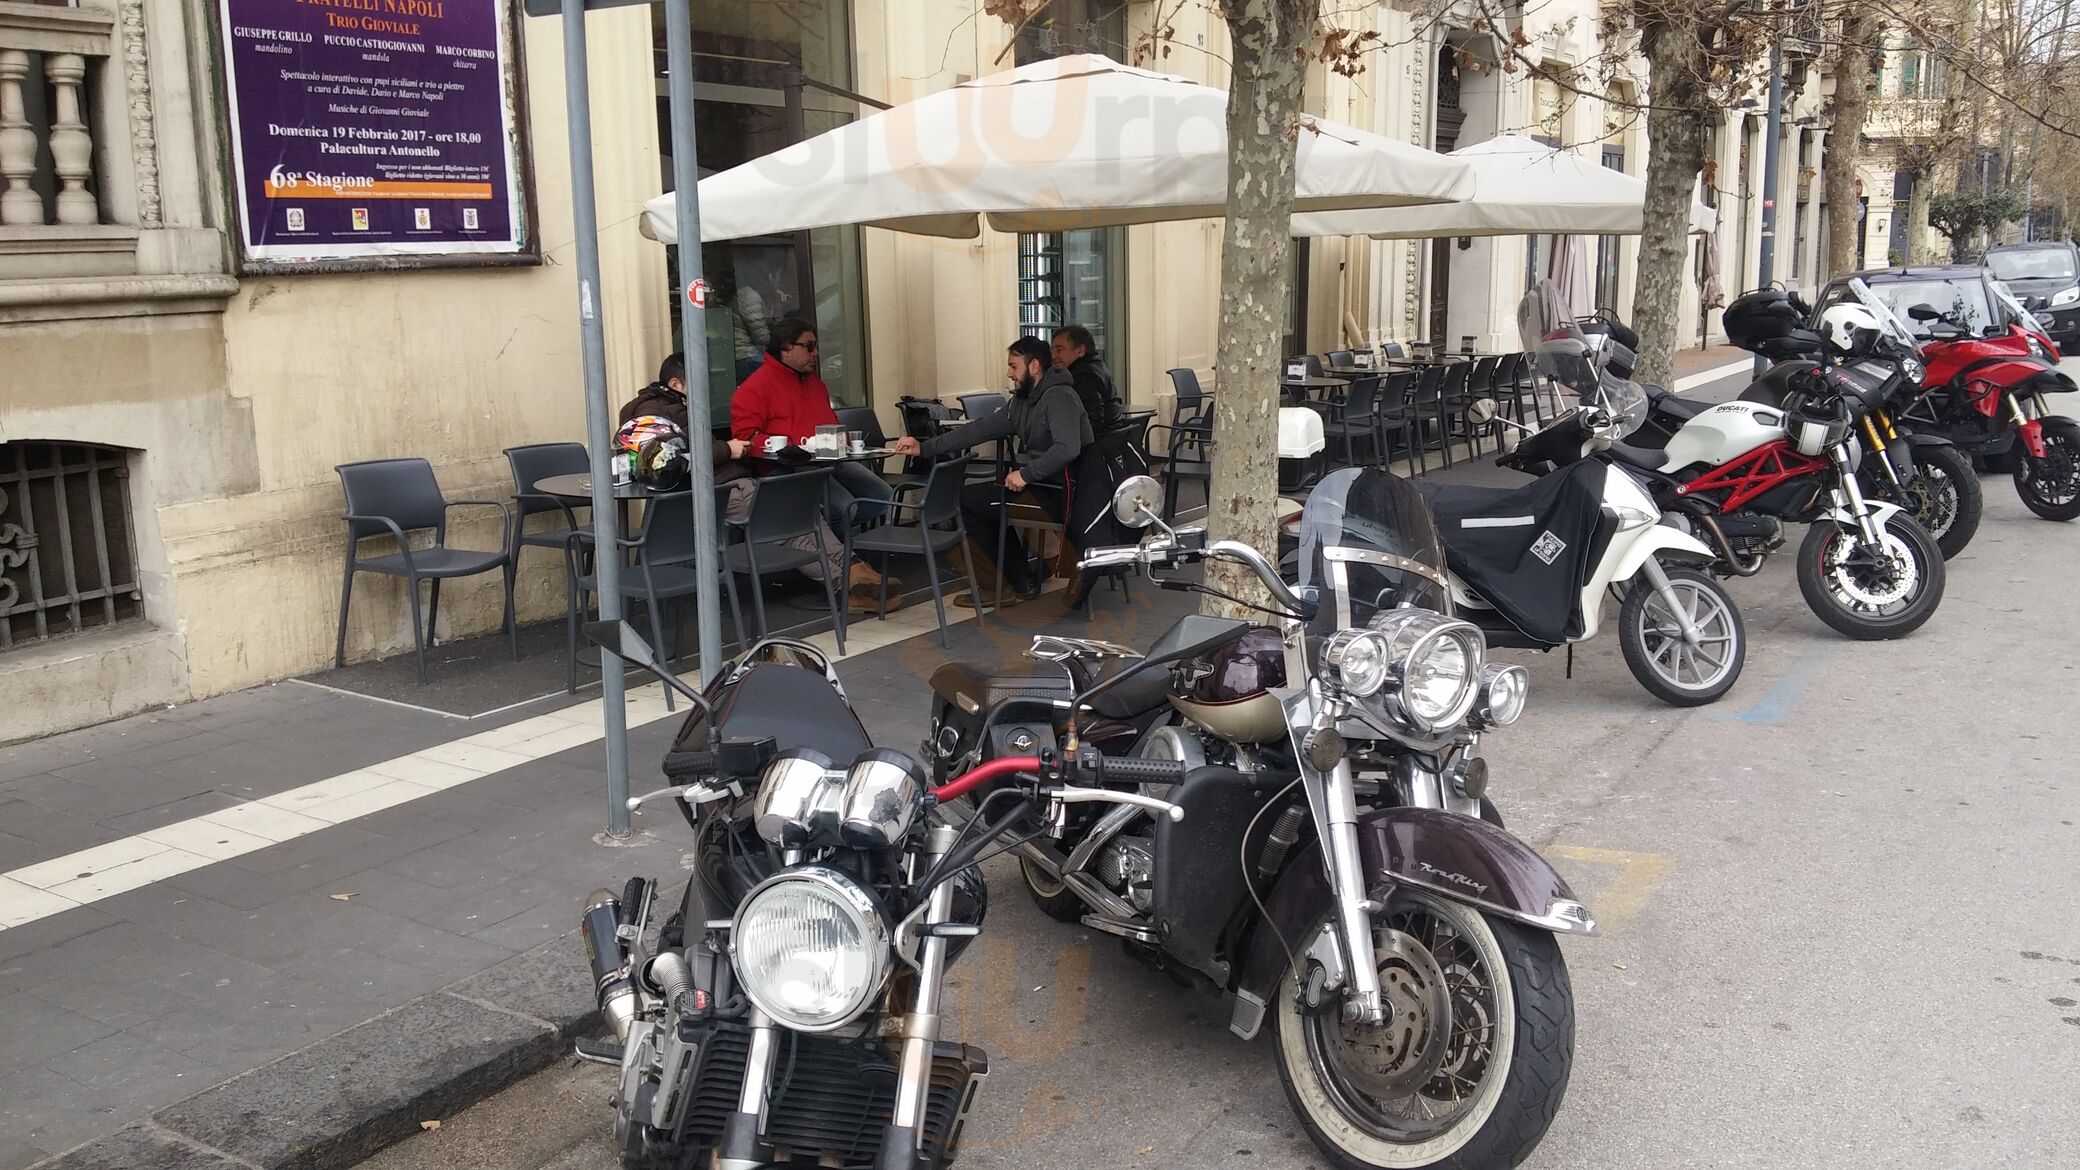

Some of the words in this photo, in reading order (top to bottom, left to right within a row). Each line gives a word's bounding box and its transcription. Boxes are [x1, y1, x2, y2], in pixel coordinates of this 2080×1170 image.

[385, 0, 443, 18] NAPOLI
[326, 12, 358, 29] TRIO
[361, 16, 420, 35] GIOVIALE
[234, 26, 277, 40] GIUSEPPE
[278, 30, 312, 43] GRILLO
[255, 43, 293, 55] mandolino
[323, 34, 356, 47] PUCCIO
[356, 37, 425, 53] CASTROGIOVANNI
[435, 44, 461, 56] MARCO
[462, 47, 495, 60] CORBINO
[452, 59, 477, 70] chitarra
[280, 69, 320, 81] Spettacolo
[321, 73, 359, 84] interattivo
[360, 77, 373, 85] con
[374, 77, 390, 88] pupi
[391, 78, 418, 88] siciliani
[425, 81, 437, 90] trio
[443, 82, 465, 92] plettro
[314, 86, 331, 95] cura
[333, 86, 340, 95] di
[371, 88, 392, 98] Dario
[399, 90, 421, 99] Marco
[422, 91, 444, 102] Napoli
[328, 103, 359, 114] Musiche
[360, 105, 368, 114] di
[369, 105, 400, 117] Giovanni
[401, 107, 430, 118] Gioviale
[268, 123, 329, 138] Domenica
[332, 126, 346, 139] 19
[348, 126, 399, 141] Febbraio
[401, 129, 427, 142] 2017
[435, 133, 453, 143] ore
[455, 132, 482, 145] 18,00
[320, 141, 387, 156] Palacultura
[389, 145, 441, 158] Antonello
[305, 171, 375, 192] Stagione
